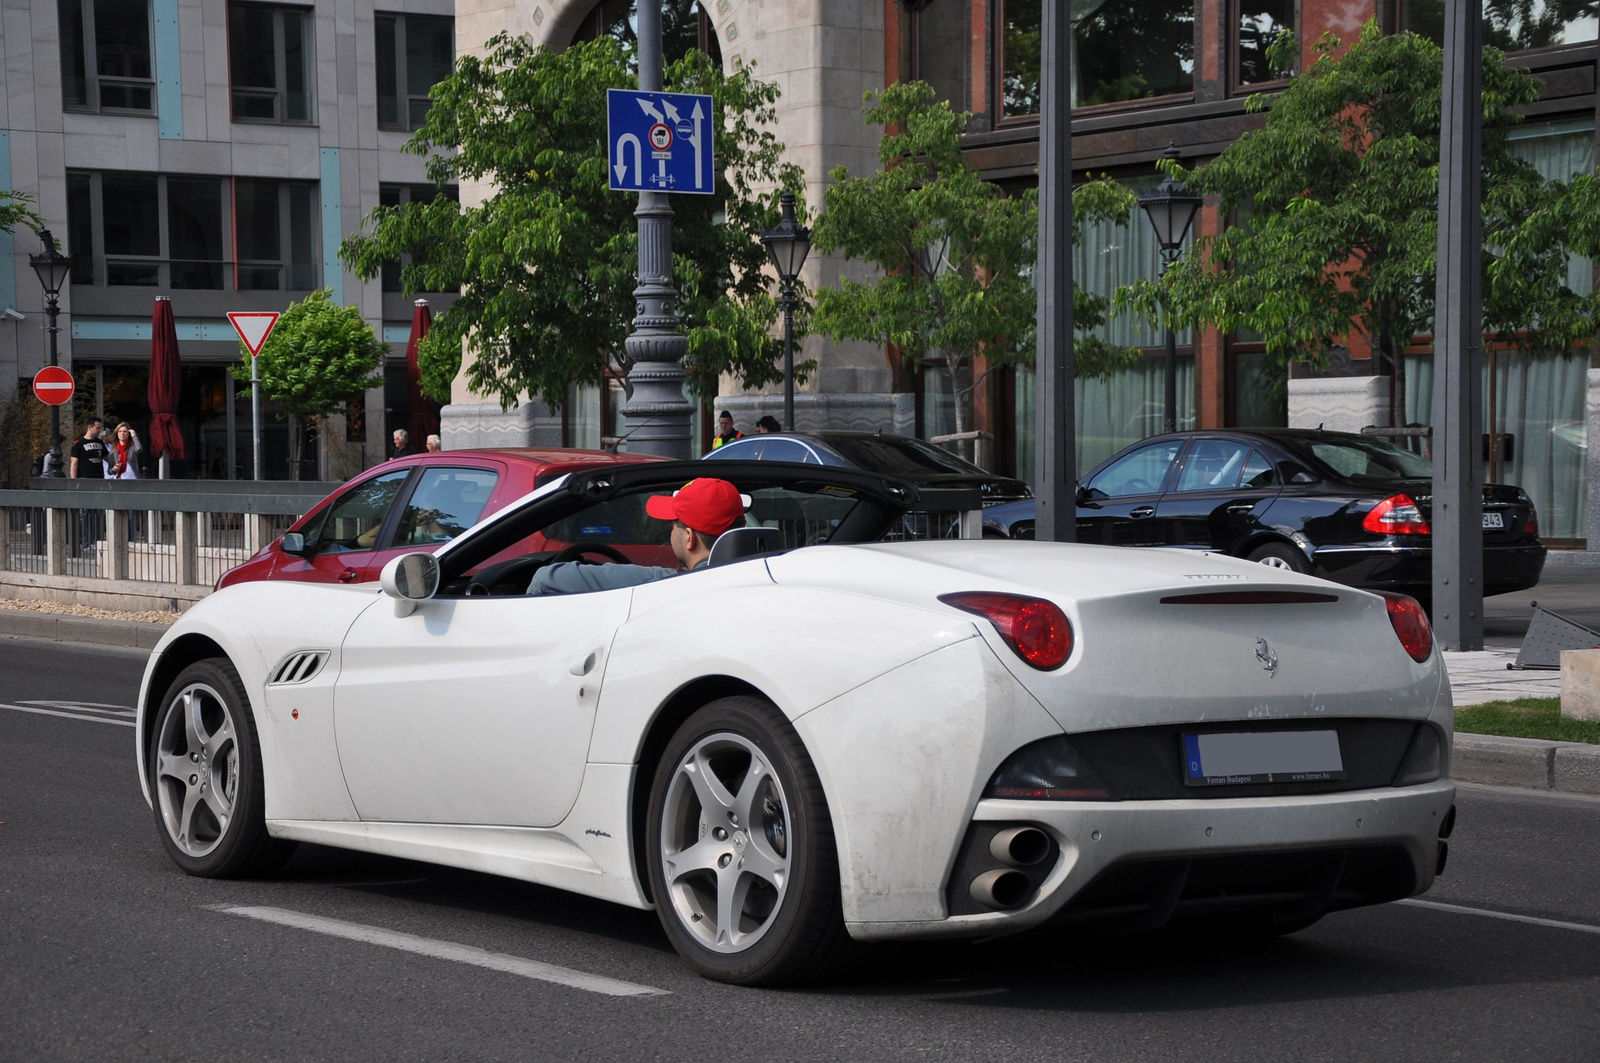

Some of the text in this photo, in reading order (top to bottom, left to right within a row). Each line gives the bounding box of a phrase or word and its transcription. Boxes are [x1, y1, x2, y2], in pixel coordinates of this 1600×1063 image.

[1483, 514, 1501, 527] 943
[1191, 761, 1199, 771] D
[1206, 775, 1252, 784] Ferrari Budapest
